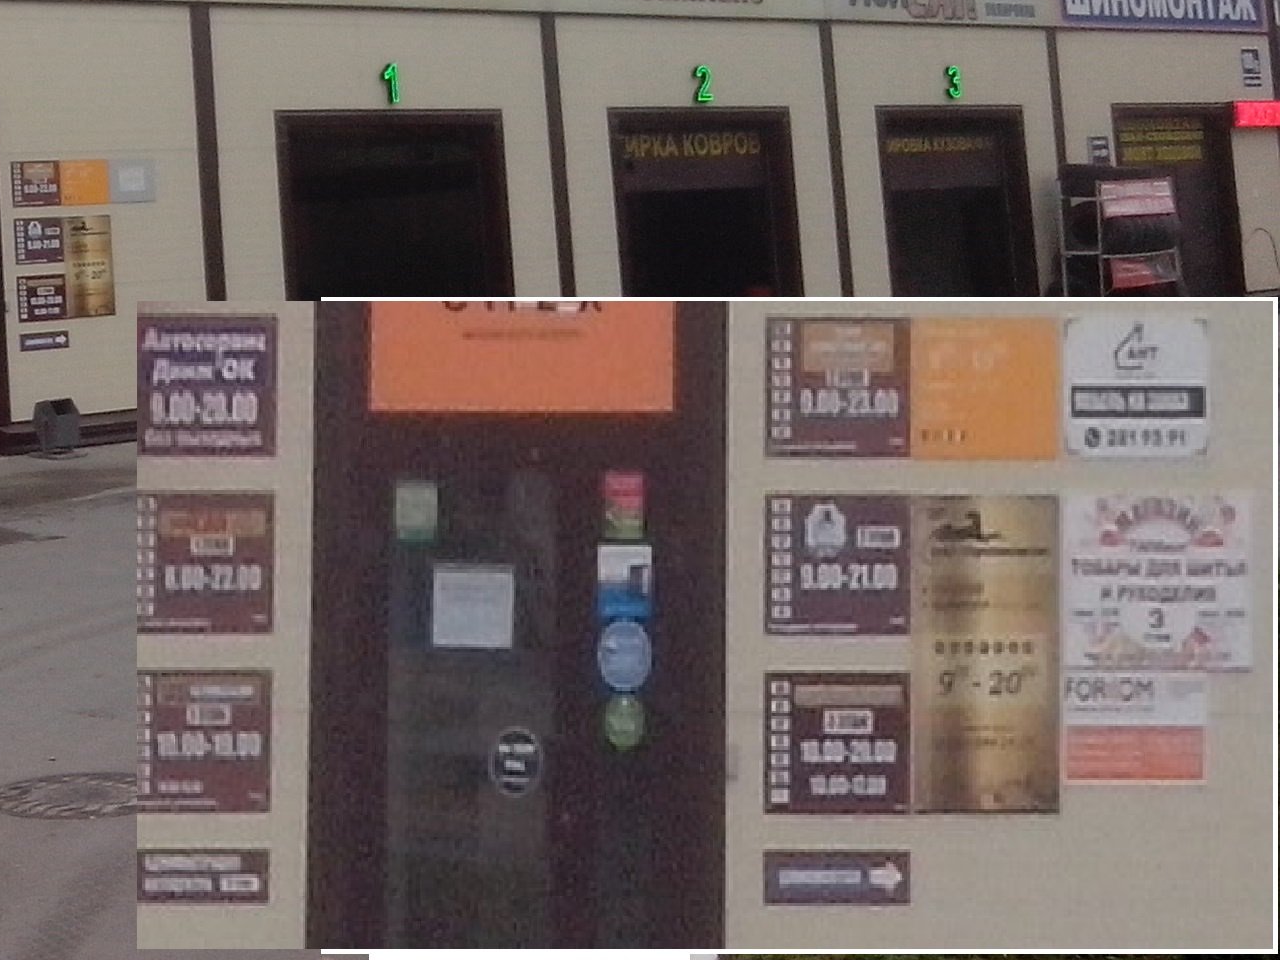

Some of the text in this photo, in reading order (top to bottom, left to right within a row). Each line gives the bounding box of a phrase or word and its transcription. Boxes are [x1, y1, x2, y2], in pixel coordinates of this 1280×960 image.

[381, 63, 402, 105] 1
[693, 65, 715, 104] 2
[945, 65, 963, 100] 3
[683, 132, 761, 156] КОВРОВ
[1148, 607, 1165, 629] 3
